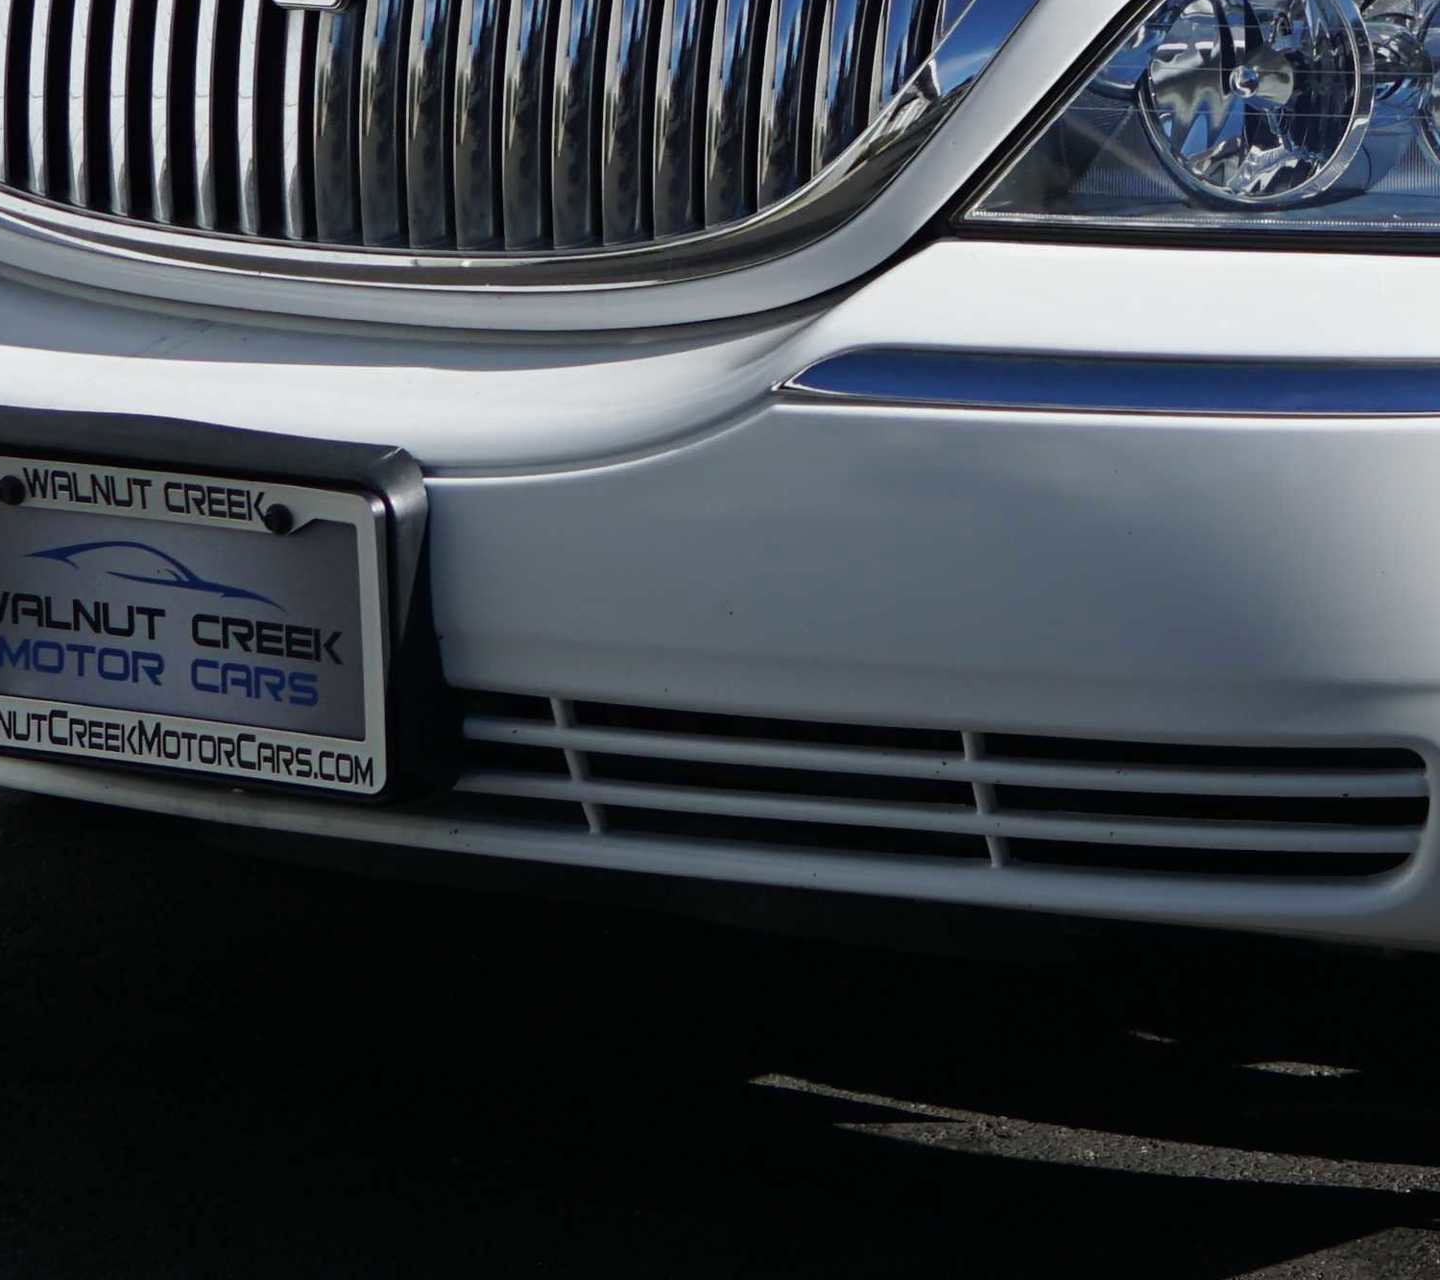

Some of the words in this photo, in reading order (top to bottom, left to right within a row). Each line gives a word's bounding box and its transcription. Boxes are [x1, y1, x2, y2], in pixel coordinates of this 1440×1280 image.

[22, 466, 152, 510] WALNUT
[163, 481, 267, 523] CREEK
[191, 613, 345, 666] CREEK
[190, 658, 320, 708] CARS
